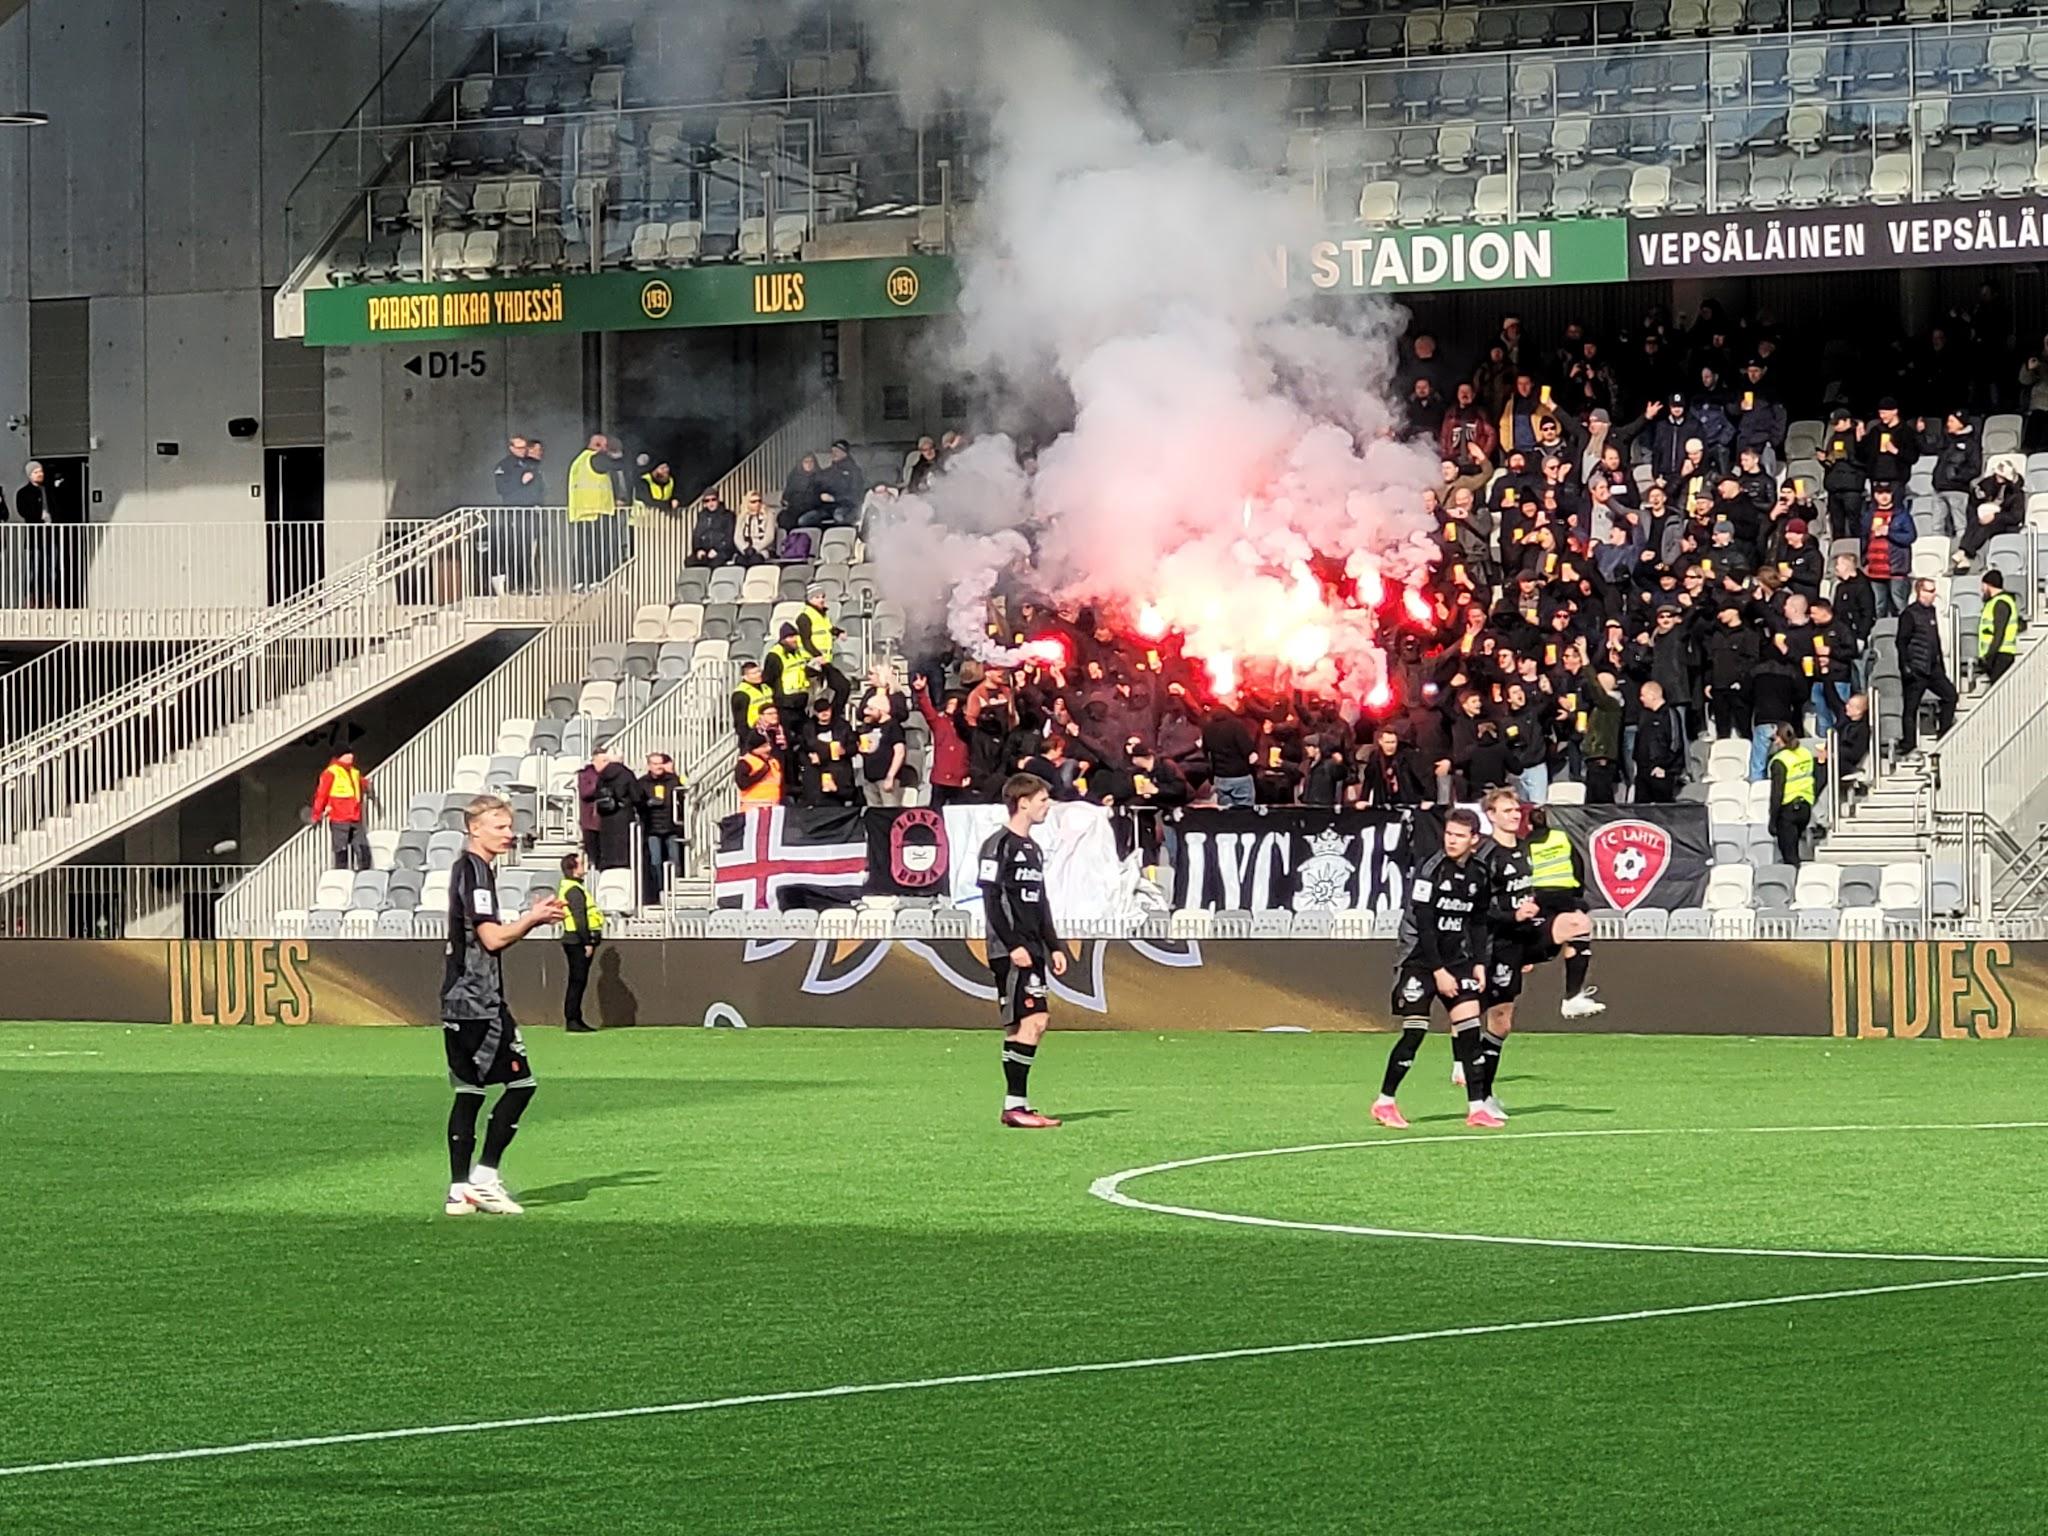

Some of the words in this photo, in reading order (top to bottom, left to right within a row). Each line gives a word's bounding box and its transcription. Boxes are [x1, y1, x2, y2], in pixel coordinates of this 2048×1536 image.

[1639, 221, 1865, 266] VEPSÄLÄINEN
[1311, 229, 1551, 289] STADION
[646, 289, 667, 310] 1931
[892, 275, 914, 297] 1931
[368, 295, 439, 331] PARASTA
[443, 292, 490, 327] AIKAA
[494, 283, 563, 324] YHDESSÄ
[429, 351, 486, 379] D1-5
[1600, 831, 1618, 849] FC
[1622, 829, 1661, 850] LAHTI
